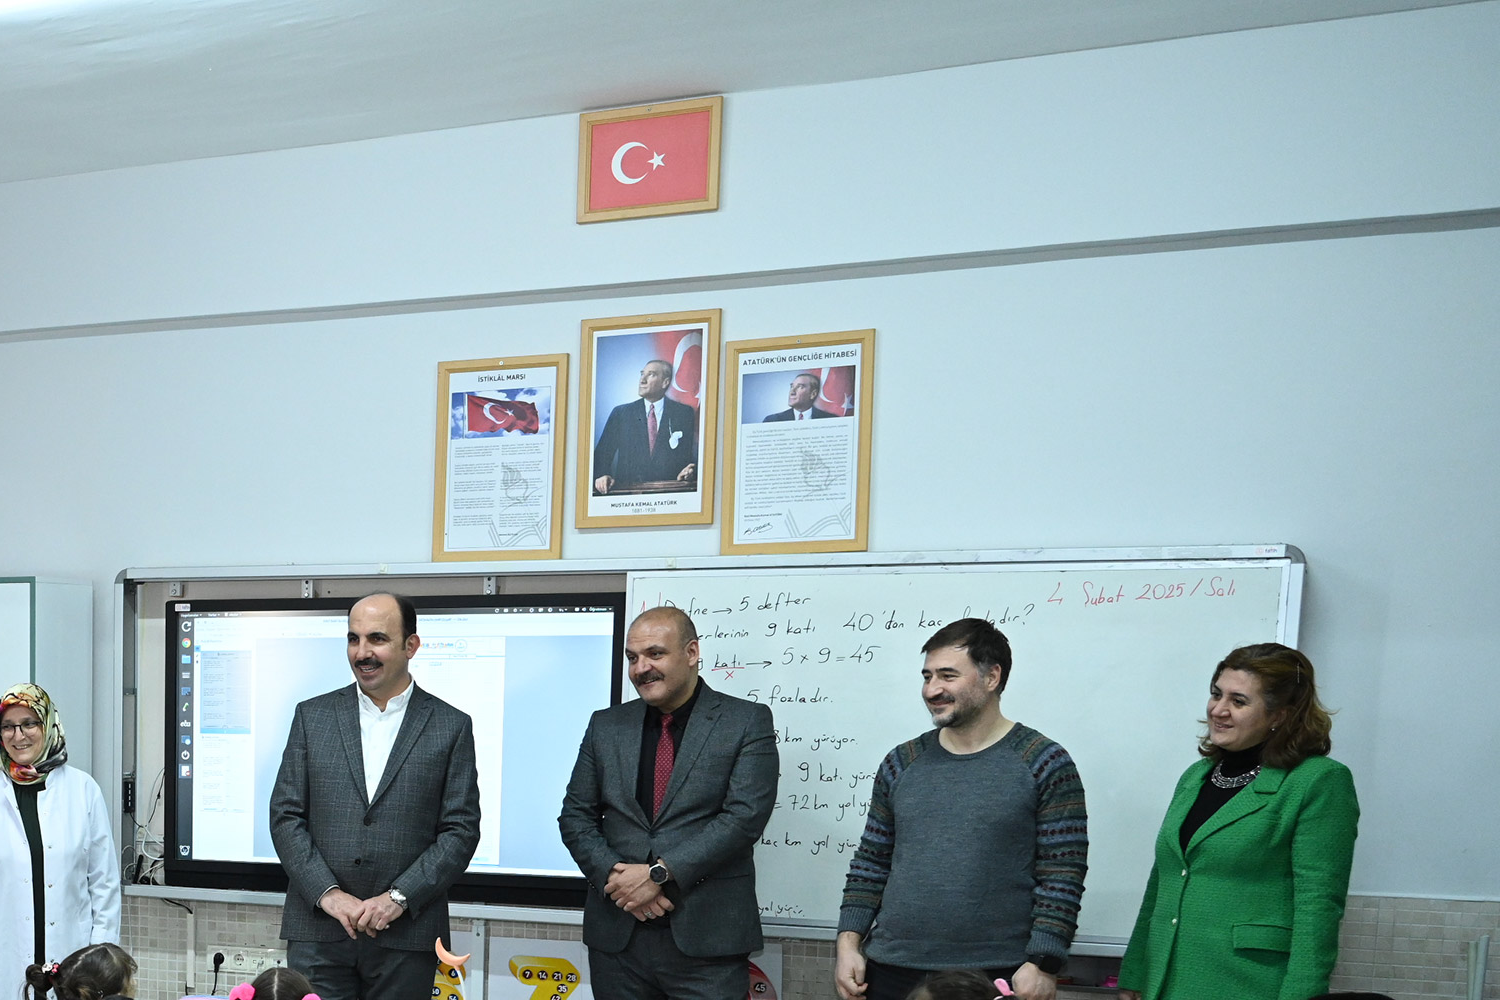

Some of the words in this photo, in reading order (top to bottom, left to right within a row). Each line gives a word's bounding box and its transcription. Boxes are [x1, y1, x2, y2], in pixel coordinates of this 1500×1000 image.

[742, 356, 787, 366] ATATÜRK'ÜN
[788, 352, 823, 363] GENÇLİĞE
[824, 349, 857, 359] HİTABESİ
[477, 375, 505, 383] İSTİKLÂL
[506, 373, 526, 381] MARŞI
[1135, 583, 1187, 601] 2025
[739, 596, 750, 612] 5
[757, 592, 811, 612] defter
[697, 625, 749, 641] erlerinin
[765, 622, 777, 637] 9
[786, 619, 816, 634] katı
[842, 611, 874, 632] 40
[962, 603, 1035, 626] fladır?
[713, 653, 741, 669] katı
[781, 646, 795, 666] 5
[818, 647, 831, 664] 9
[849, 643, 882, 663] 45
[746, 688, 761, 703] 5
[797, 761, 810, 782] 9
[849, 771, 876, 789] yürü
[787, 794, 810, 811] 72
[785, 831, 802, 846] km
[810, 834, 830, 856] yol
[837, 838, 859, 854] yür
[523, 970, 532, 979] 7
[538, 971, 547, 980] 14
[553, 972, 562, 981] 21
[566, 973, 577, 982] 28
[557, 984, 568, 993] 35
[754, 983, 766, 992] 45
